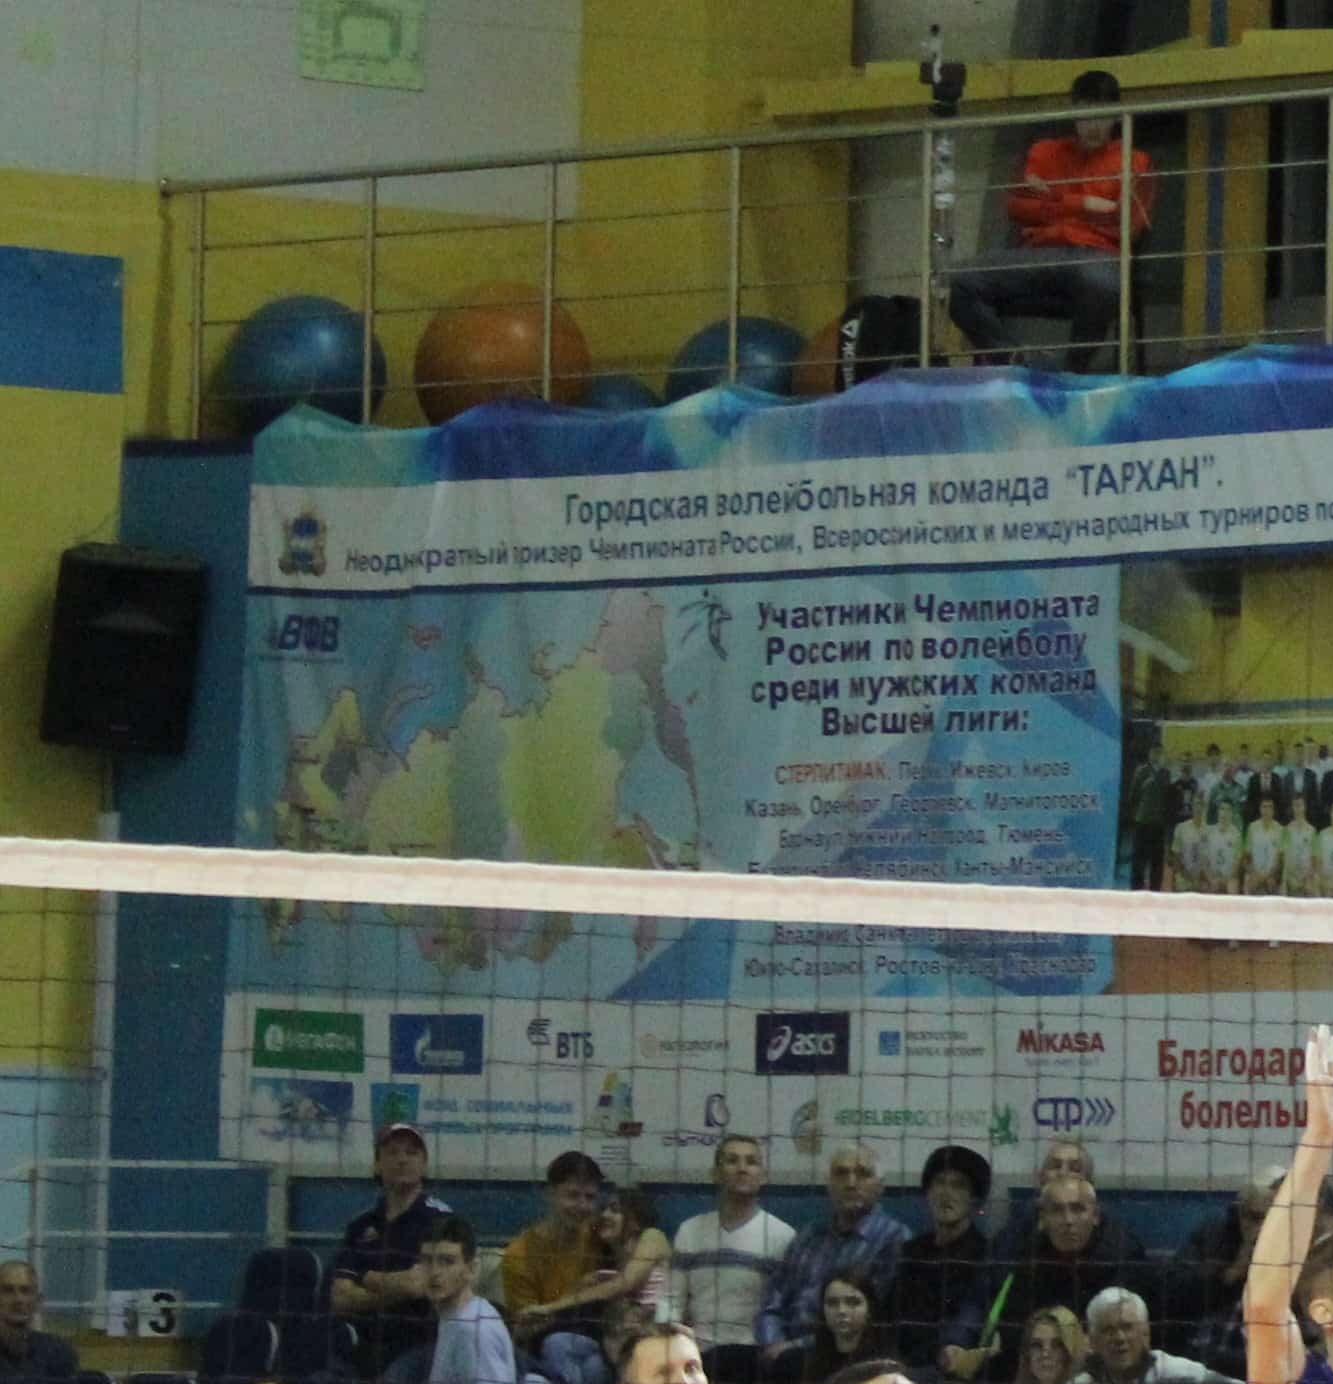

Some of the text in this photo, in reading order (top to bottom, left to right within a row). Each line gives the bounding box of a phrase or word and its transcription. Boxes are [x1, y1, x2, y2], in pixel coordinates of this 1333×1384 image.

[566, 493, 708, 530] Городская
[715, 479, 916, 517] волейбольная
[929, 475, 1049, 508] команда
[589, 537, 717, 560] Чемпионата
[813, 521, 976, 551] Всероссийских
[1002, 510, 1190, 546] международных
[1199, 503, 1309, 534] турниров
[757, 594, 1100, 631] Участники Чемпионата
[766, 629, 1087, 665] России по волейболу
[750, 668, 1097, 709] среди мужских команд
[821, 704, 1030, 737] Высшей лиги:
[556, 1032, 594, 1058] ВТБ
[790, 1029, 836, 1056] asics
[150, 1291, 178, 1335] 3
